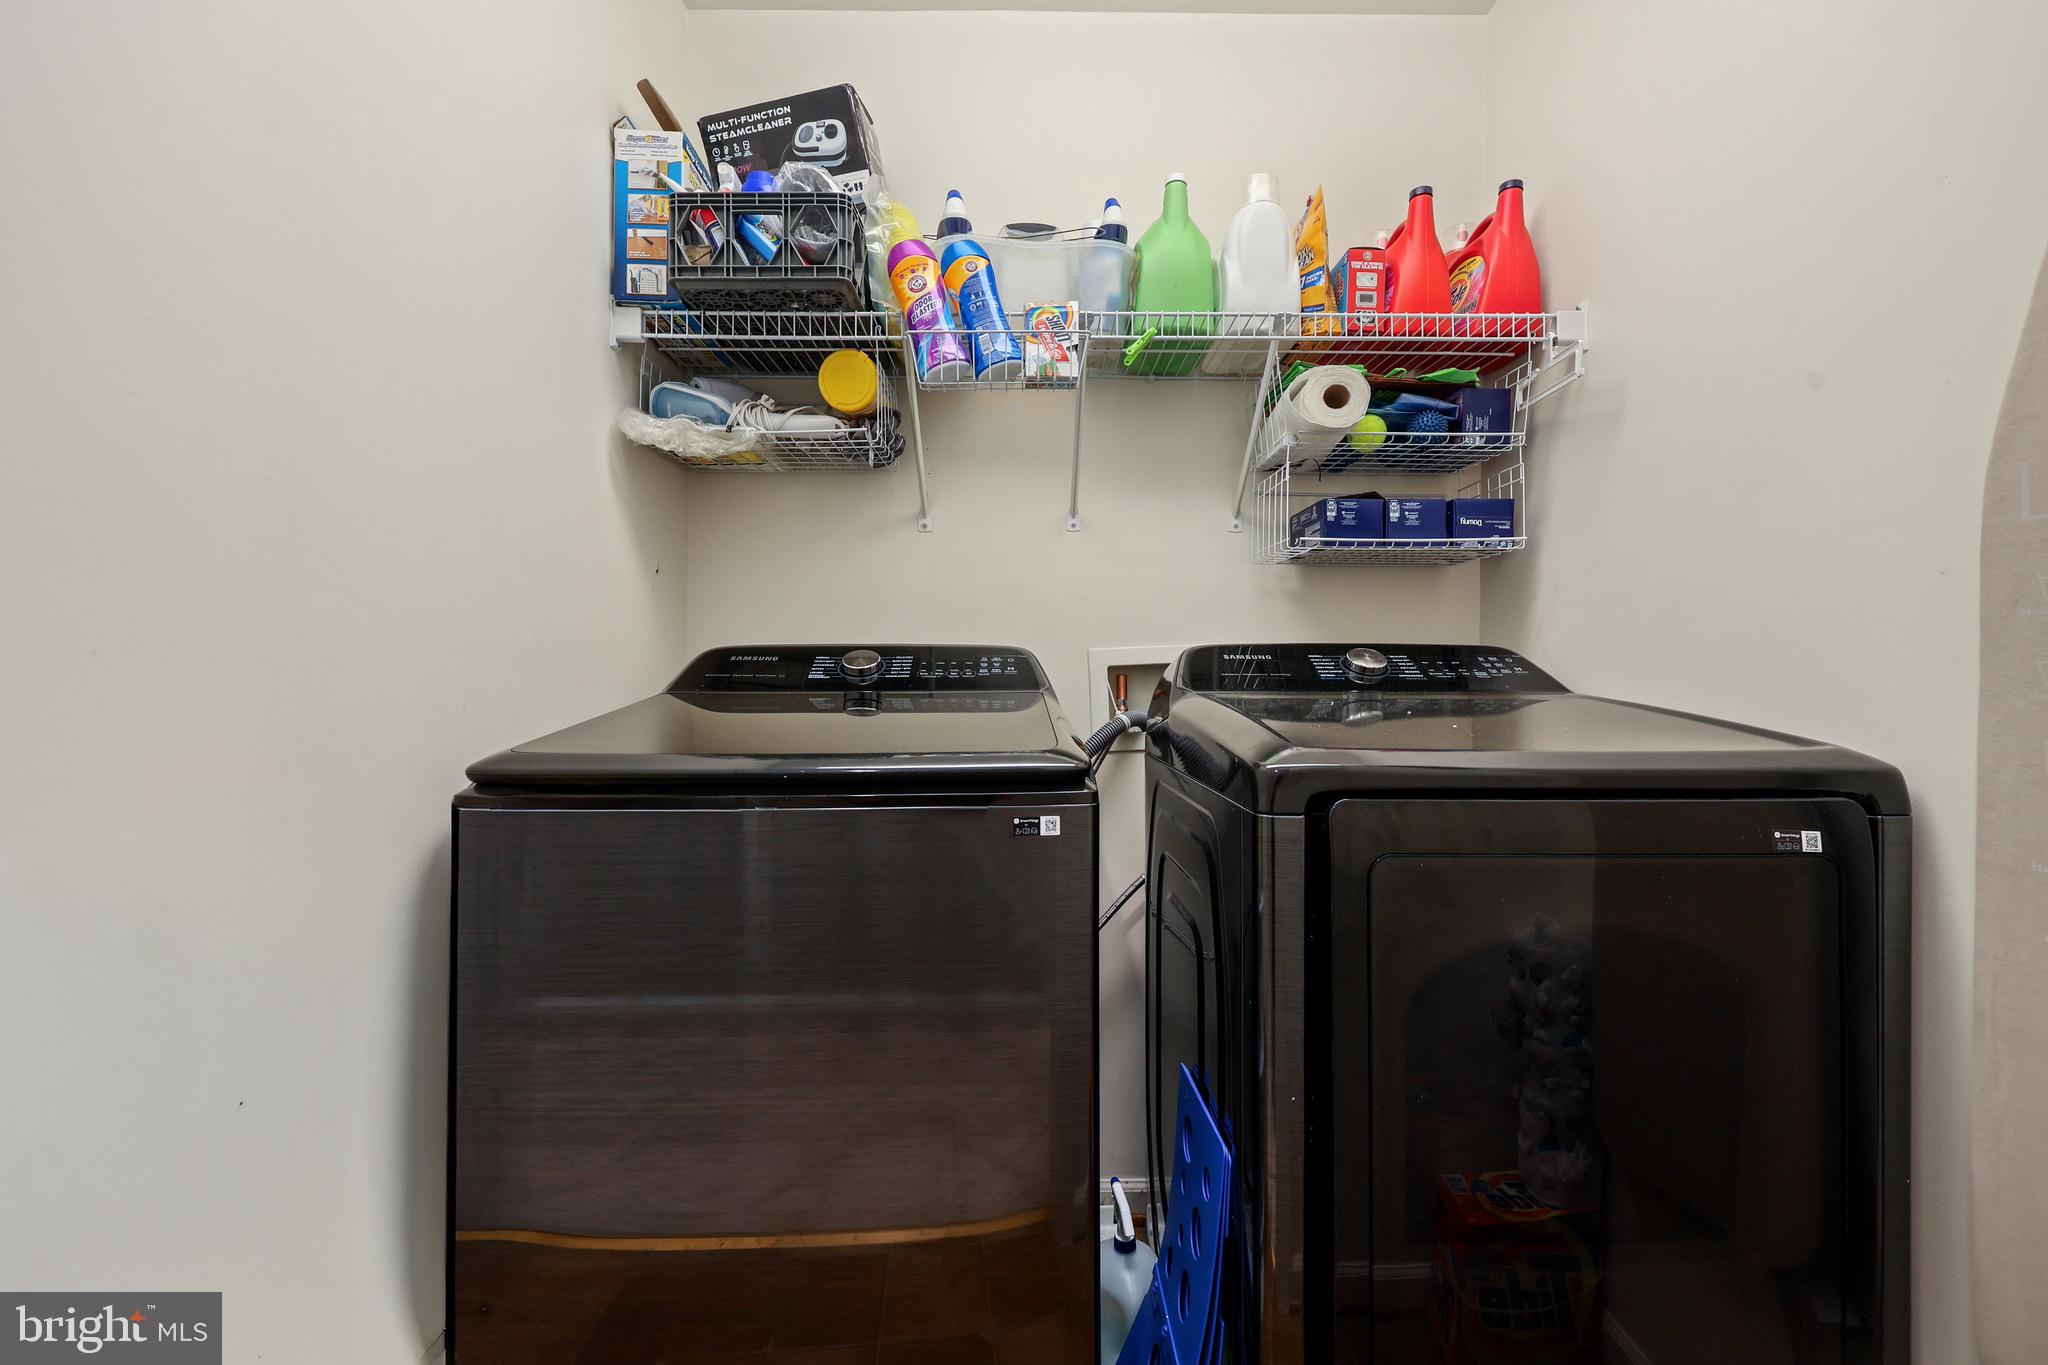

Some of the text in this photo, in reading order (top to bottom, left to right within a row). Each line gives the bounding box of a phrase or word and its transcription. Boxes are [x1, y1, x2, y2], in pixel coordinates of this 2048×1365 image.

[707, 105, 791, 132] MULTI-FUNCTION
[709, 117, 792, 143] STEAMCLEANER
[914, 295, 933, 311] ODOR
